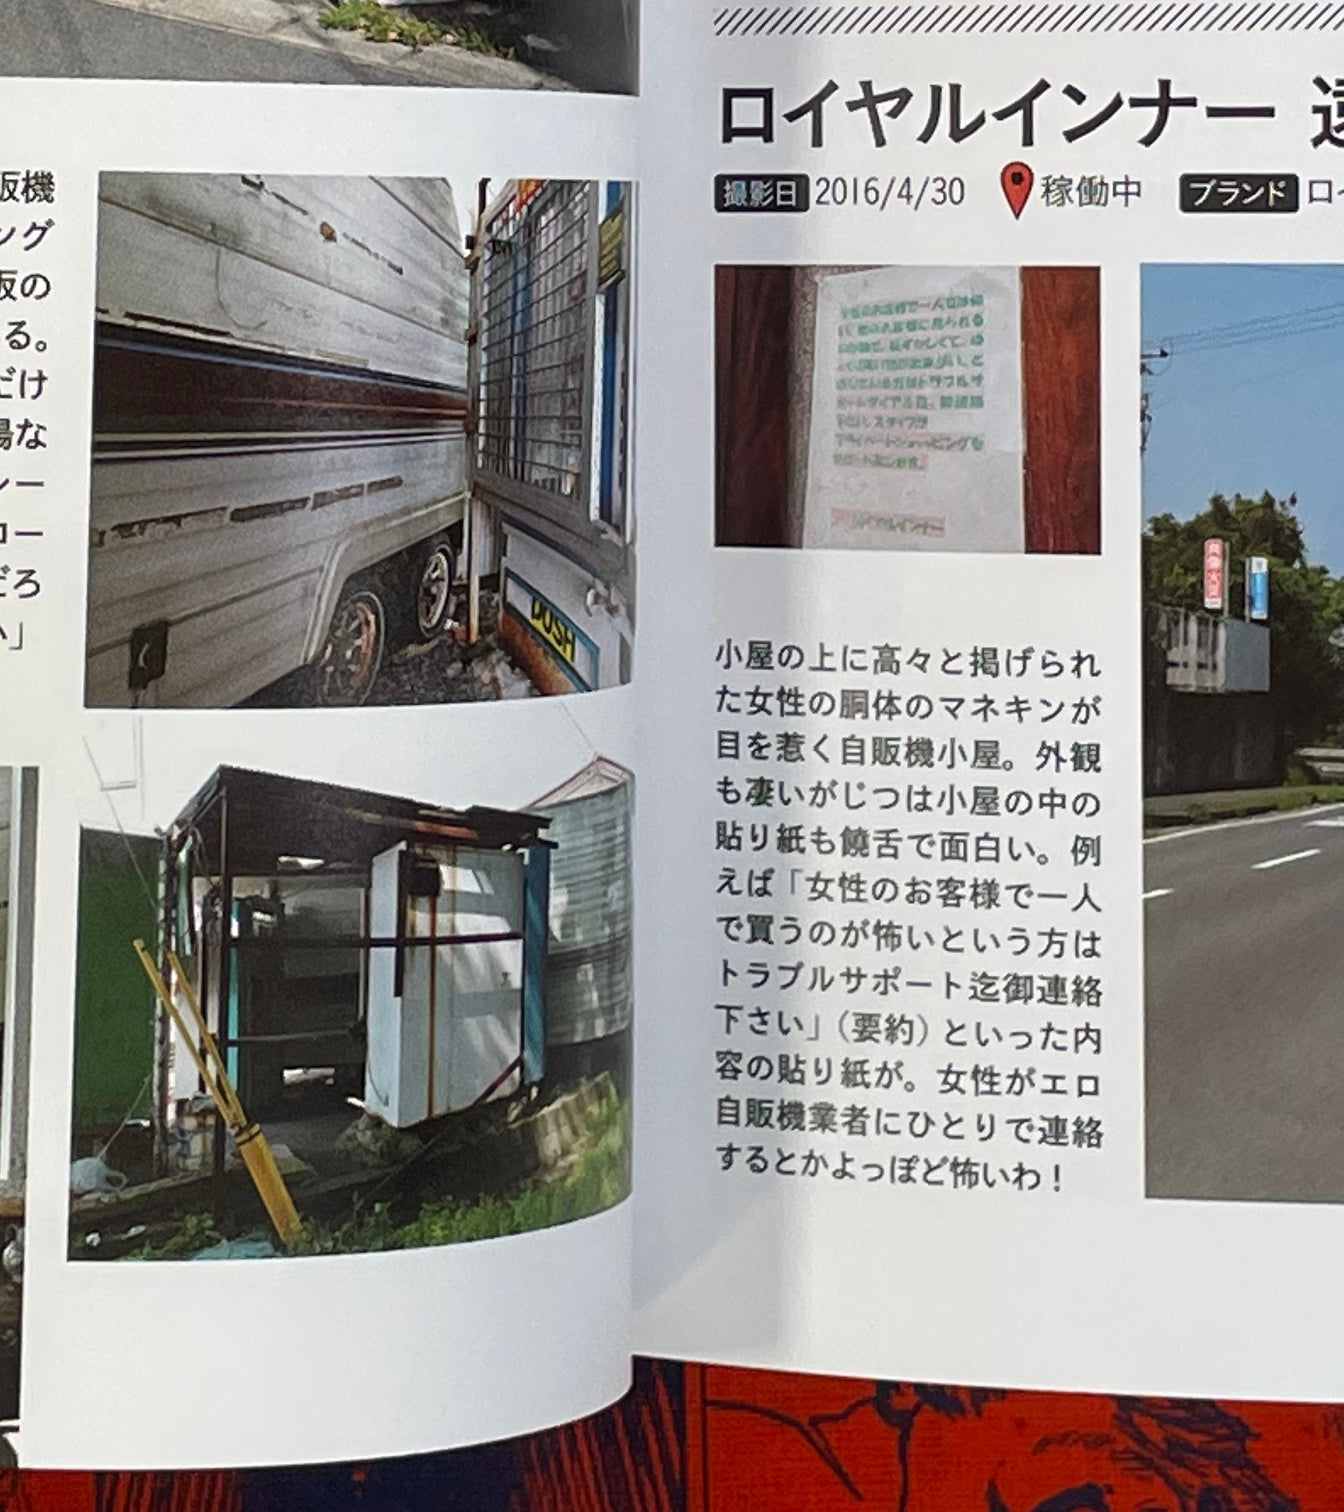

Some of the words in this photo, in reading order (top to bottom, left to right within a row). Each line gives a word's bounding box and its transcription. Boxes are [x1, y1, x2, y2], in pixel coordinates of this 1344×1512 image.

[722, 79, 1276, 149] ロイヤルインナー
[723, 179, 798, 210] 撮影日
[815, 174, 966, 211] 2016/4/30
[1041, 174, 1142, 209] 稼働中
[1190, 181, 1286, 206] ブランド
[715, 638, 1103, 679] 小屋の上に高々と掲げられ
[715, 684, 1103, 726] た女性の胴体のマネキンが
[715, 730, 1103, 774] 目を惹く自販機小屋。外観
[715, 776, 1103, 820] も凄いがじつは小屋の中の
[715, 821, 1103, 867] 貼り紙も饒舌で面白い。例
[715, 913, 1103, 959] で買うのが怖いという方は
[715, 959, 1103, 1008] トラブルサポート迄御連絡
[715, 1051, 1103, 1098] 容の貼り紙が。女性がエロ
[715, 1095, 1103, 1149] 自販機業者にひとりで連絡
